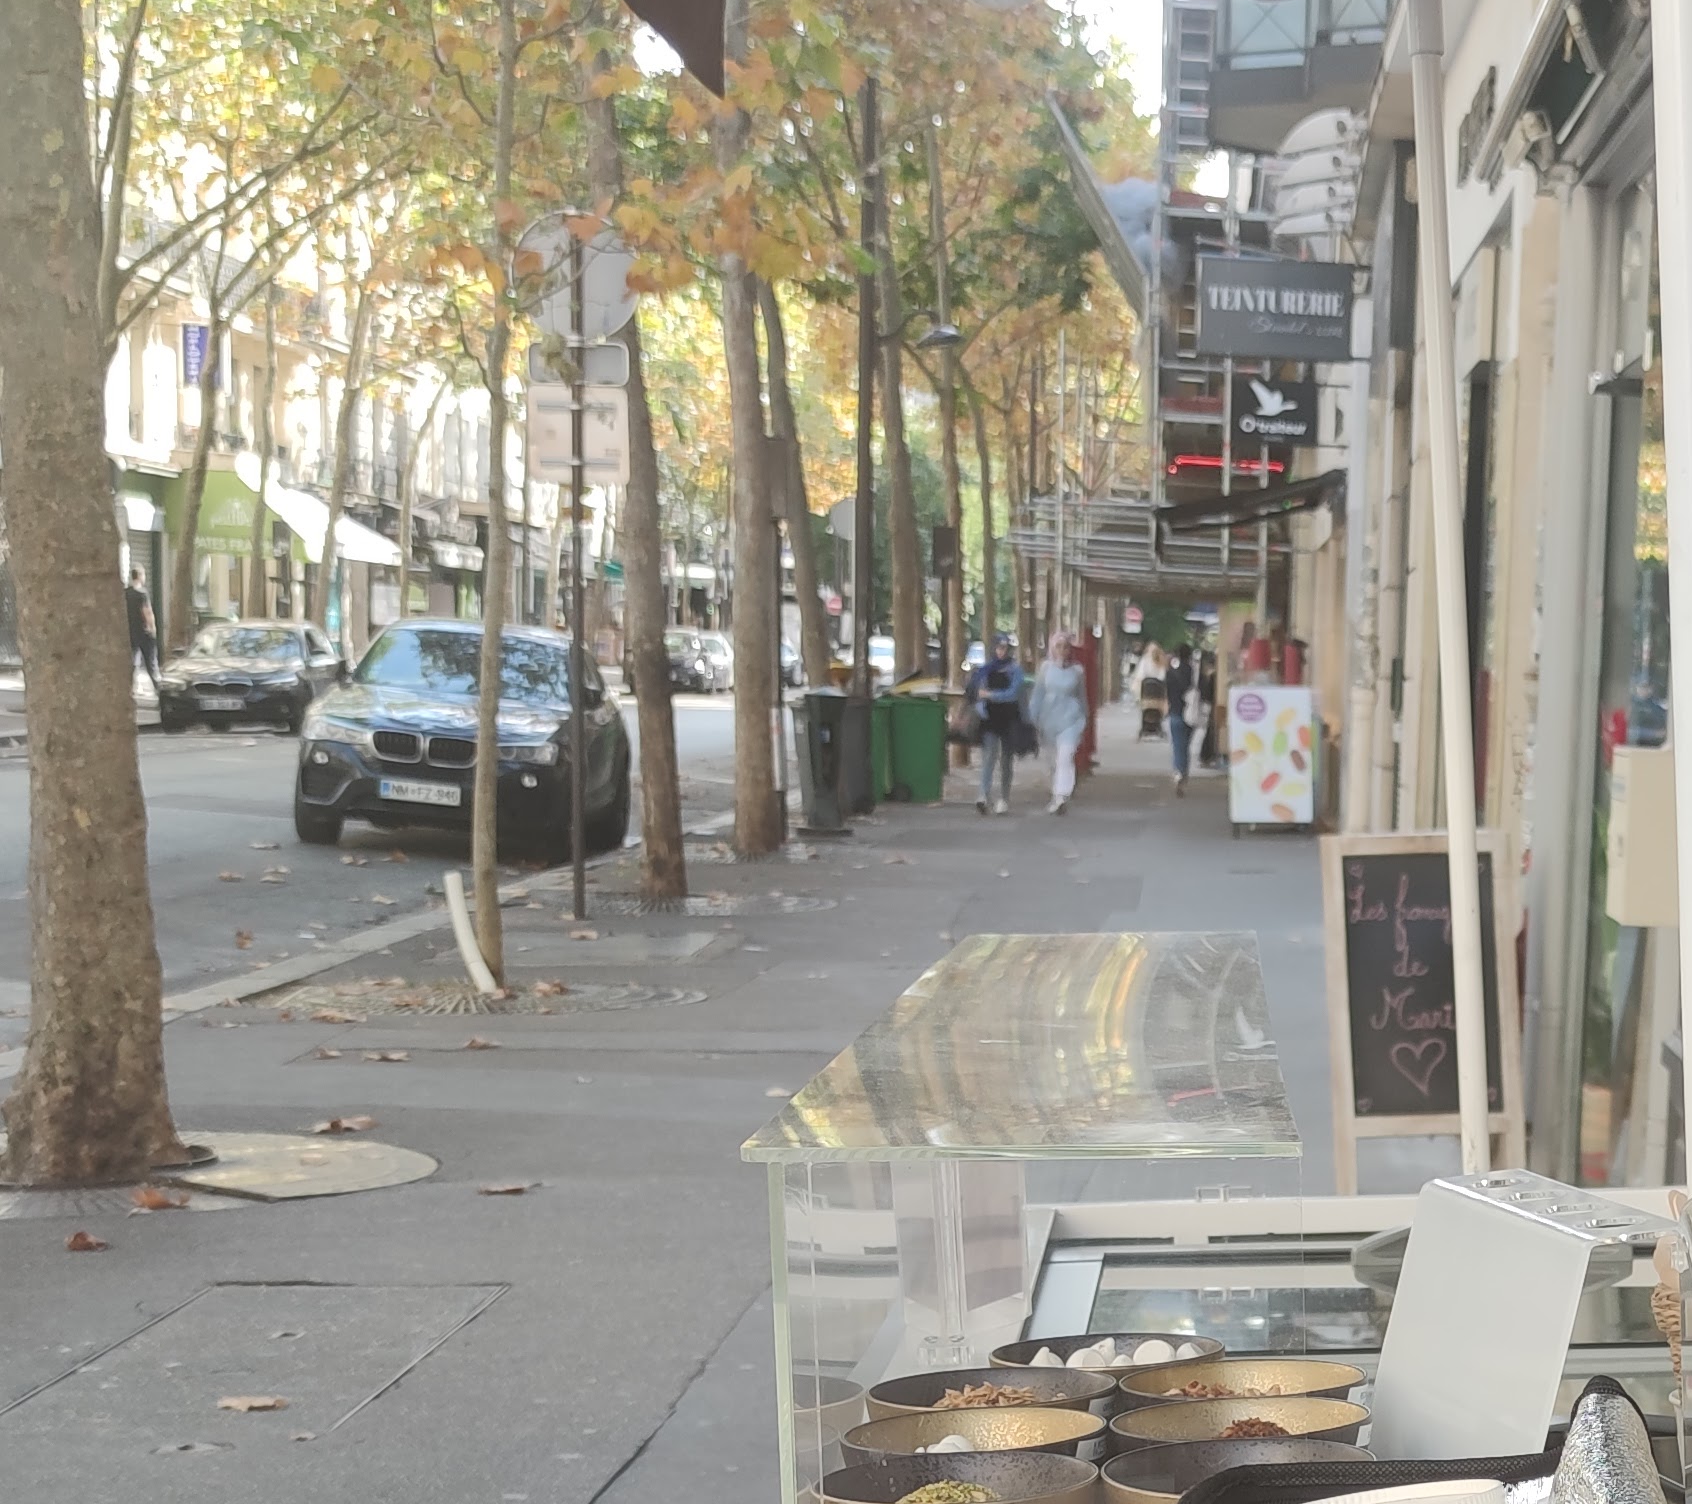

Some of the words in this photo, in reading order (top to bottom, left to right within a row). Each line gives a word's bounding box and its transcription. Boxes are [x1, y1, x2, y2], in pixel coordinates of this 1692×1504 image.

[1208, 285, 1345, 318] TEINTURERIE
[1348, 884, 1388, 925] Les
[1392, 945, 1429, 978] de
[1369, 985, 1456, 1031] Mari
